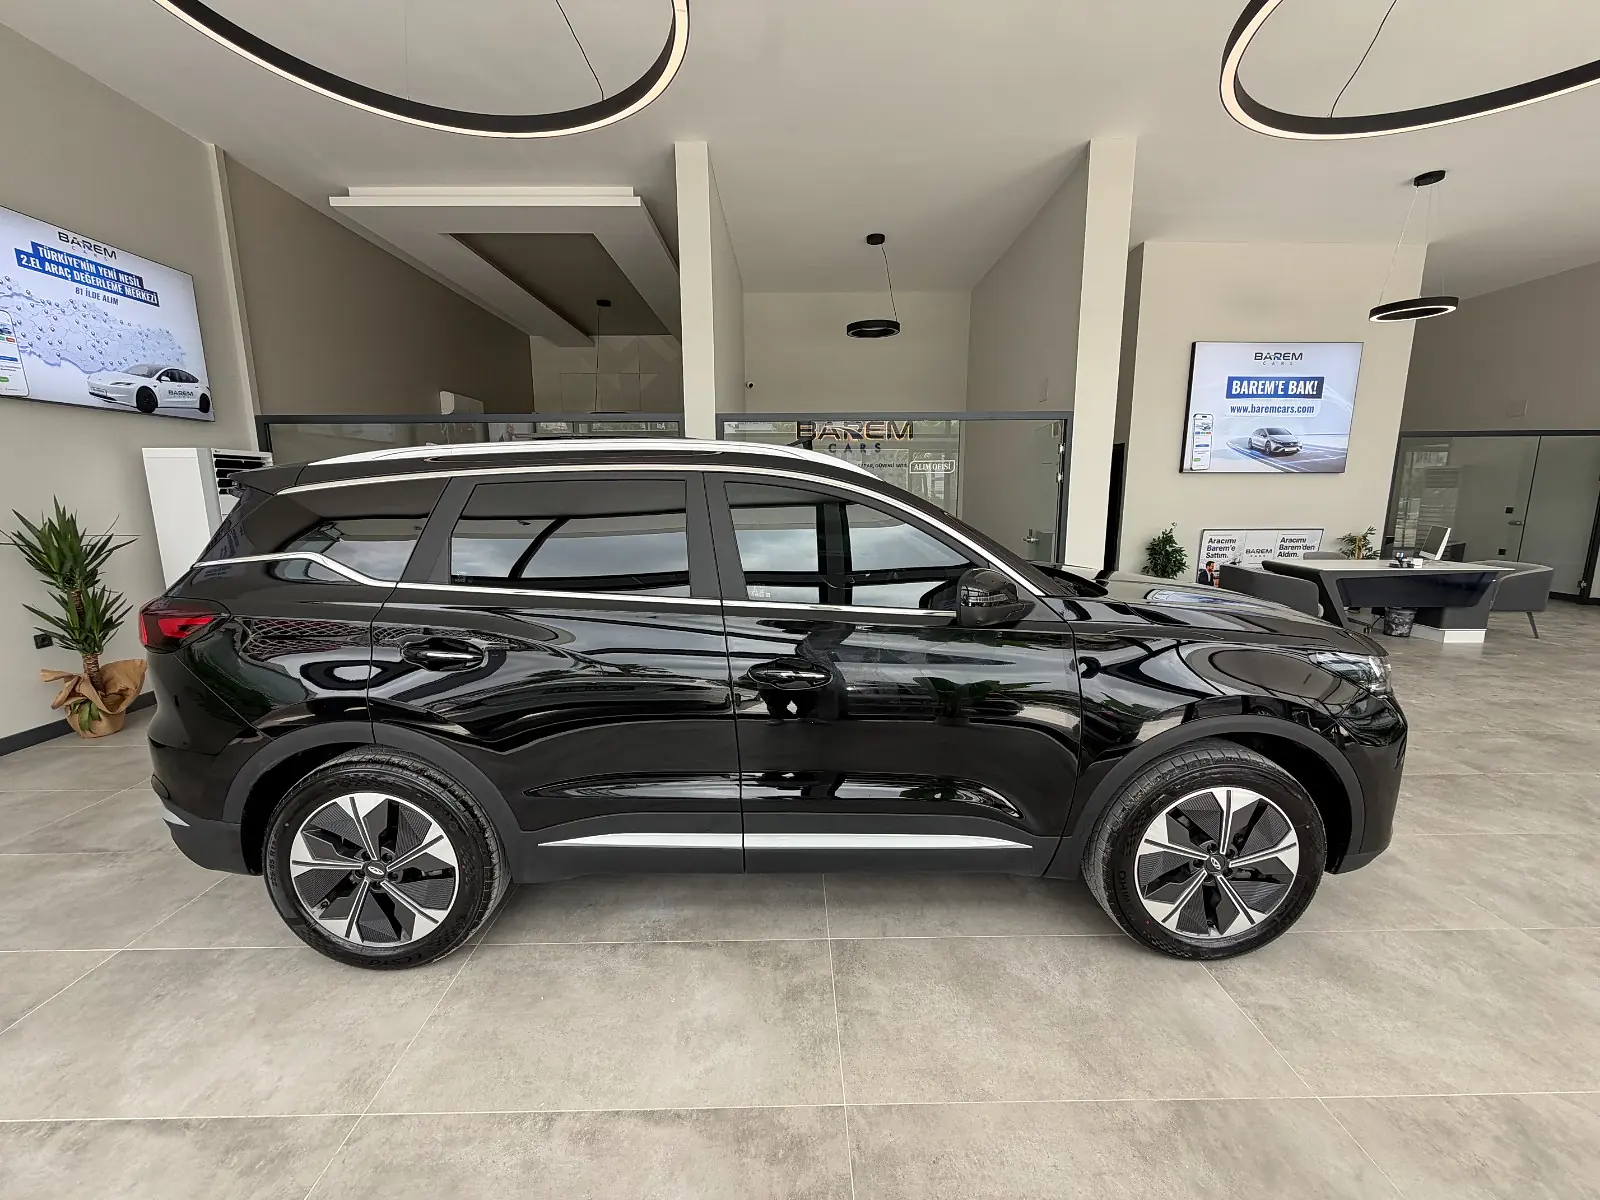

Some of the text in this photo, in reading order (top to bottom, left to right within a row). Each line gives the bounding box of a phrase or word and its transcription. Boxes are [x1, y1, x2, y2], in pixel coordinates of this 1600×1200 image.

[58, 231, 117, 260] BAREM
[37, 246, 143, 288] TÜRKİYE'NİN YENİ NESİL
[20, 255, 158, 303] 2.EL ARAÇ DEĞERLEME MERKEZİ
[85, 287, 101, 300] İLDE
[102, 294, 119, 305] ALIM
[1254, 352, 1304, 361] BAREM
[1231, 379, 1318, 395] BAREM'E BAK!
[1230, 404, 1315, 414] www.baremcars.com
[796, 419, 914, 441] BAREM
[828, 442, 881, 453] CARS
